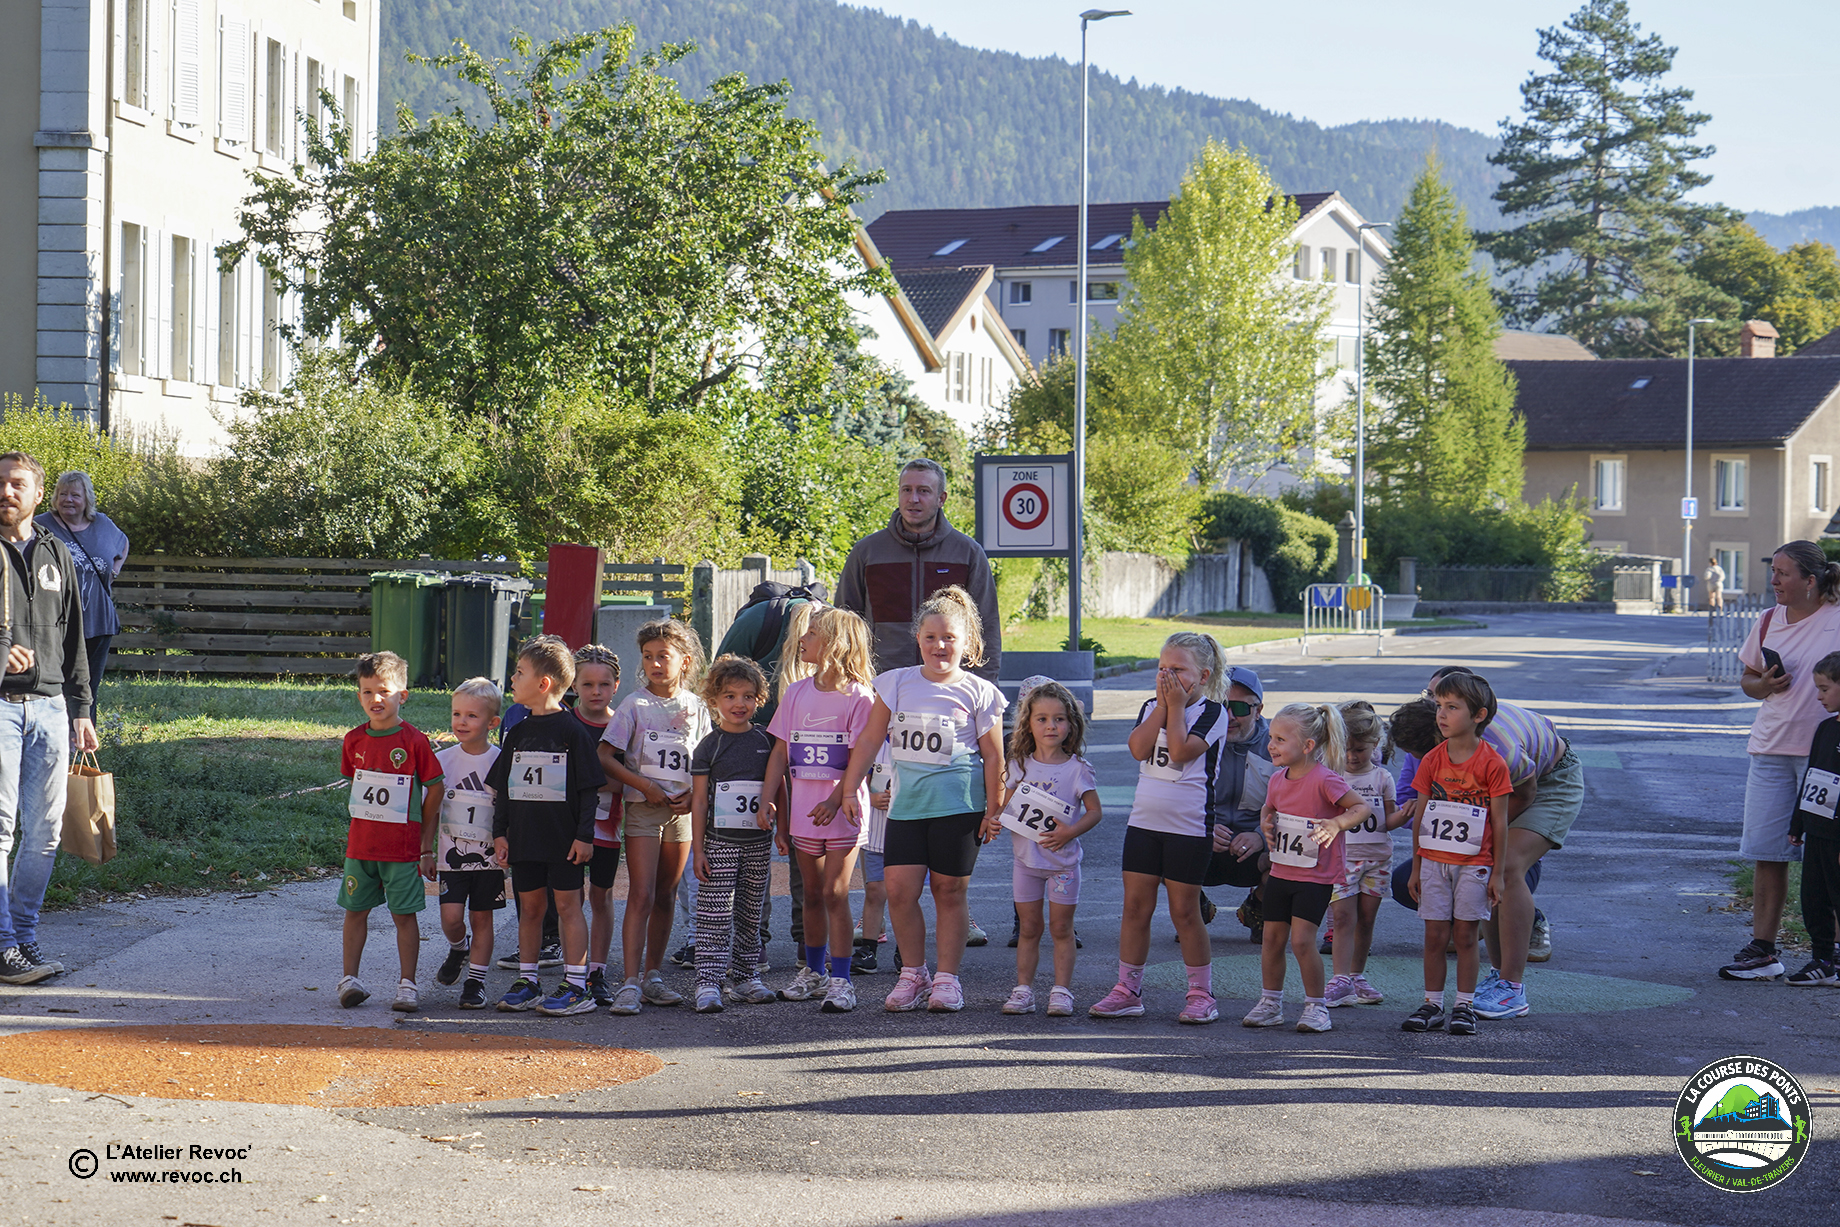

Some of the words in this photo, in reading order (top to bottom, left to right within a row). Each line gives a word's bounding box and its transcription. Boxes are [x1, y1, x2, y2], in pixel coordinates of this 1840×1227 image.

[1012, 471, 1039, 481] ZONE
[1016, 498, 1035, 515] 30
[901, 730, 942, 753] 100
[657, 749, 689, 773] 131
[803, 745, 829, 765] 35
[523, 766, 542, 785] 41
[363, 786, 390, 806] 40
[1802, 783, 1828, 805] 128
[364, 810, 384, 819] Rayan
[736, 795, 760, 814] 36
[467, 806, 476, 824] 1
[1017, 803, 1058, 833] 129
[459, 830, 476, 838] Louis
[1431, 818, 1469, 843] 123
[1276, 831, 1304, 856] 114
